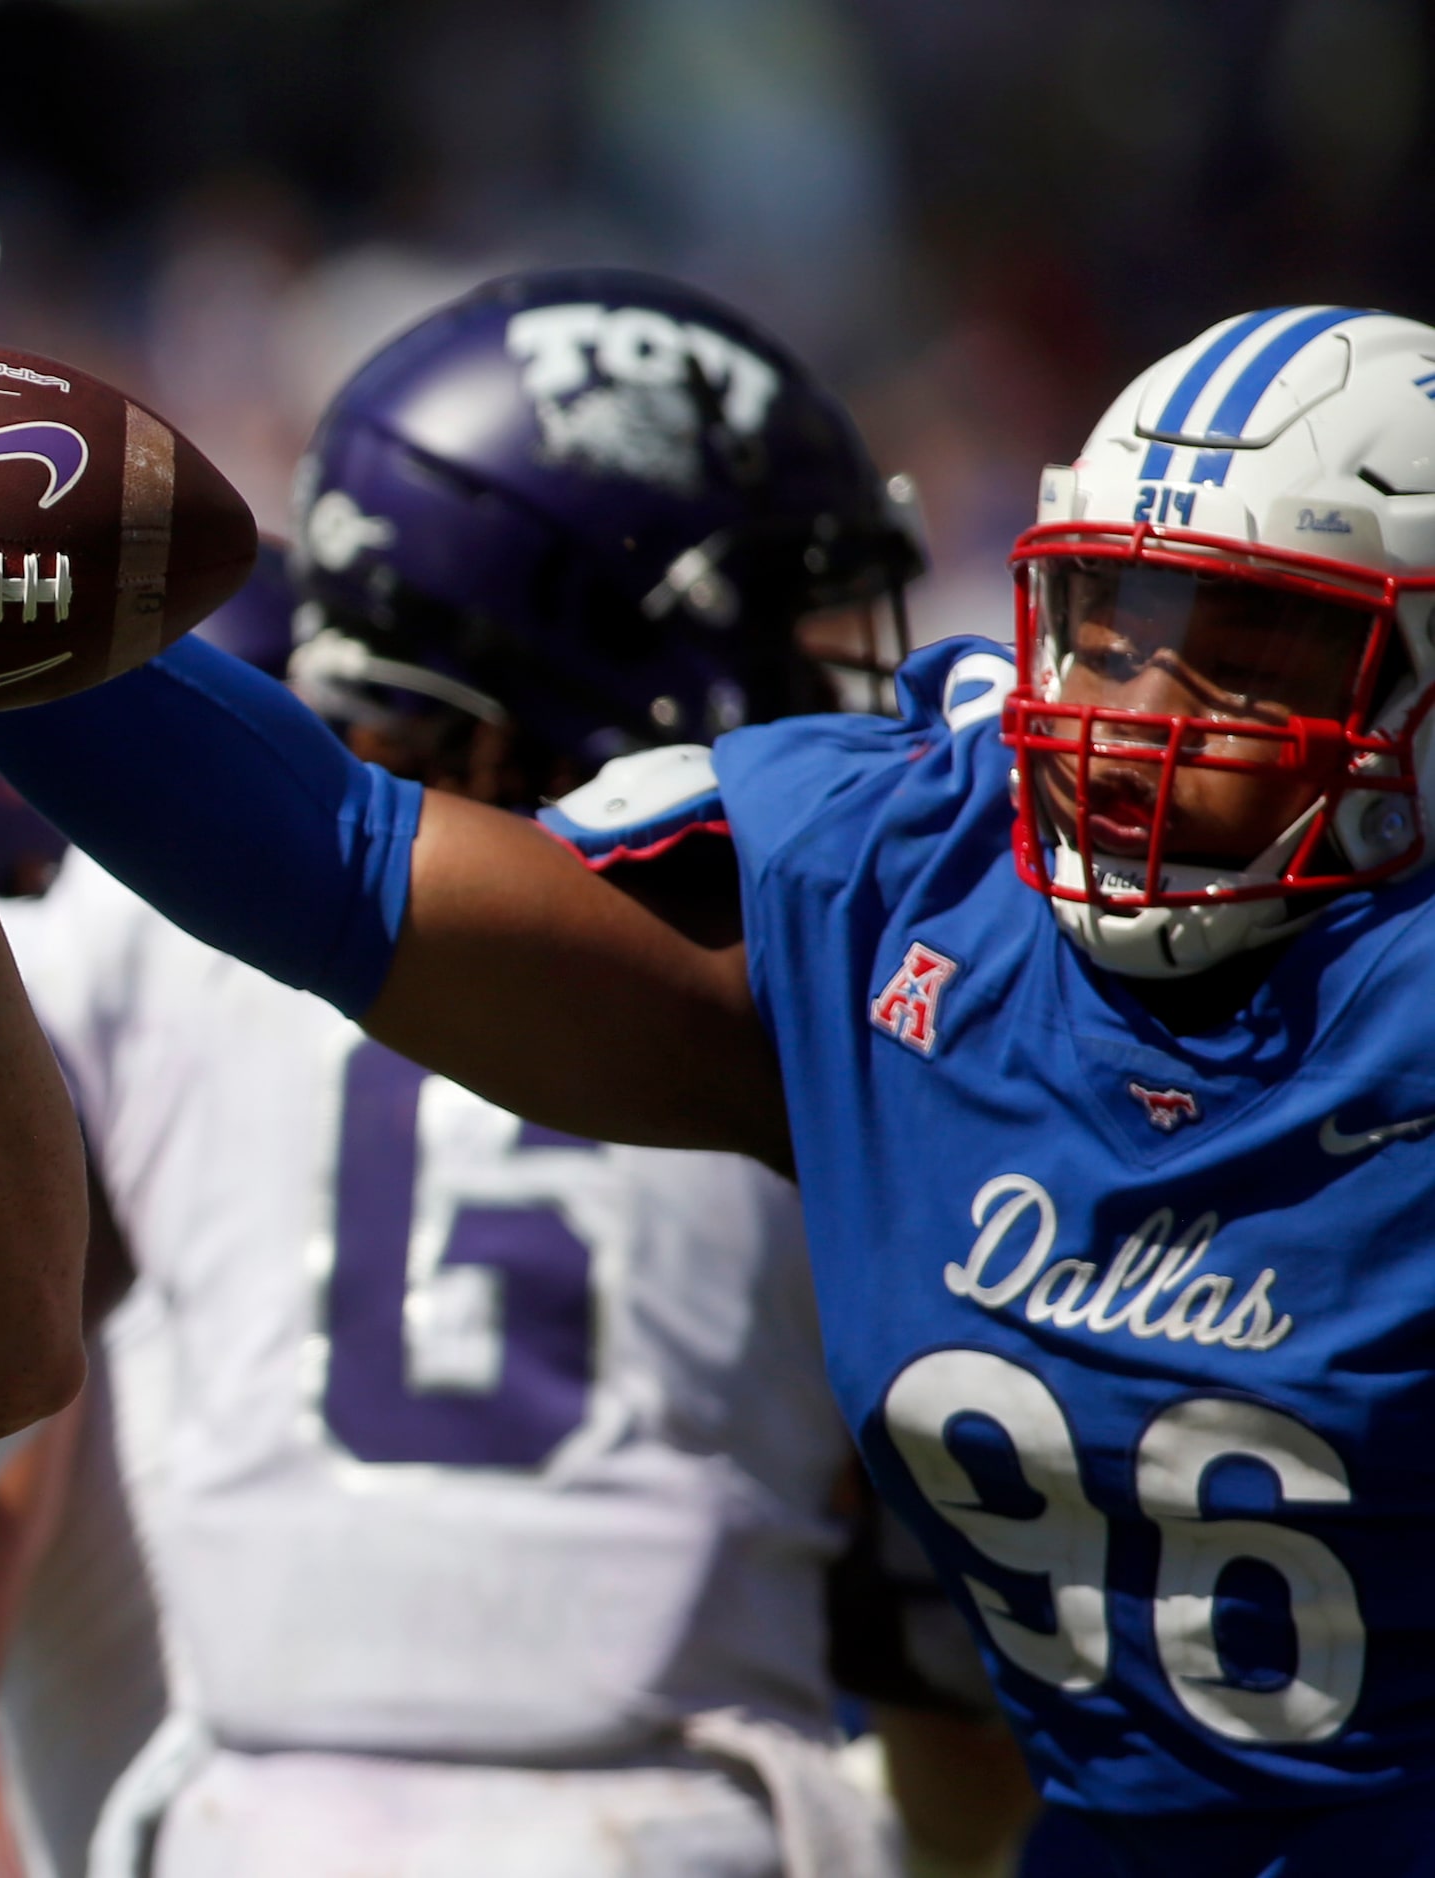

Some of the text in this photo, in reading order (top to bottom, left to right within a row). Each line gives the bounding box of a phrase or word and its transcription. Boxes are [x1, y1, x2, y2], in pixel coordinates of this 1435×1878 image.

[1133, 486, 1196, 527] 214
[316, 1030, 616, 1474] 6
[944, 1173, 1294, 1351] Dallas
[884, 1347, 1366, 1744] 96
